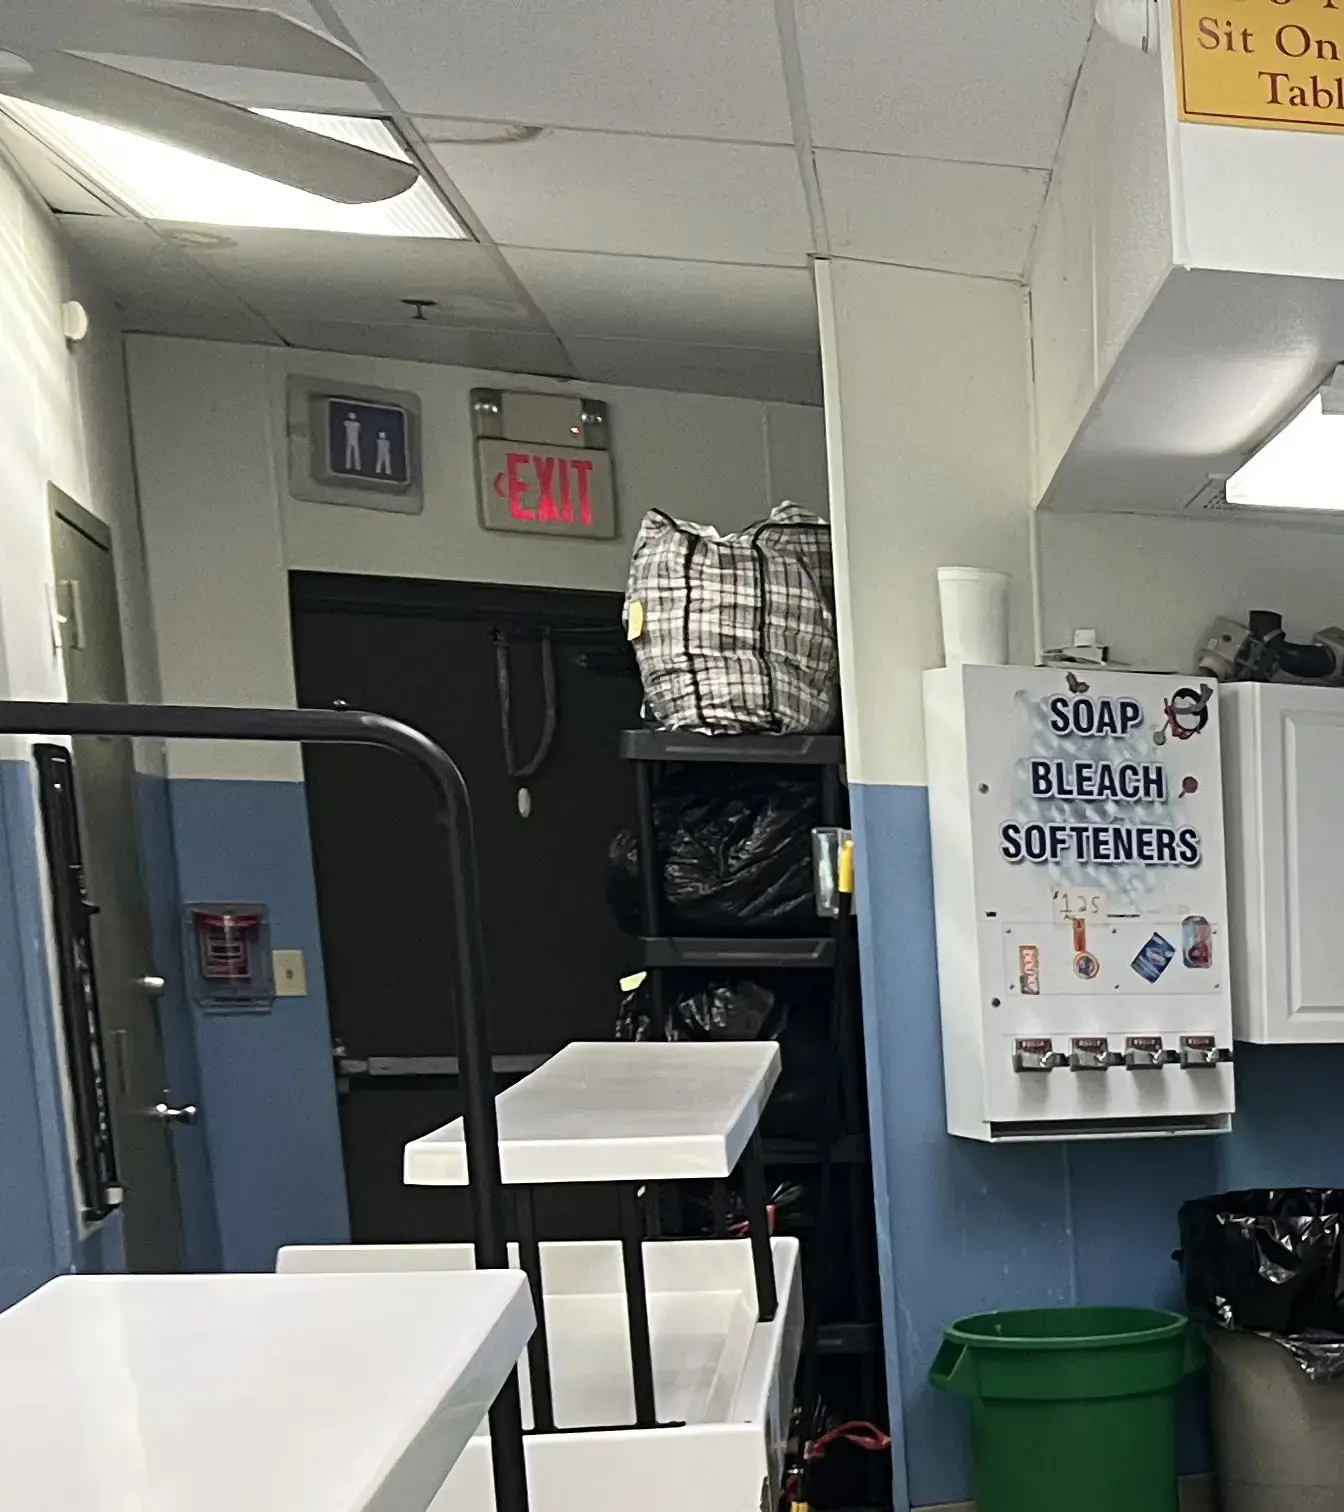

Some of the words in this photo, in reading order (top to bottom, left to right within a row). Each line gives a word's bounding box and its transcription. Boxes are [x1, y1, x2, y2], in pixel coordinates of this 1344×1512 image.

[1196, 16, 1255, 54] Sit
[1275, 24, 1341, 61] On
[506, 452, 593, 526] EXIT
[1049, 696, 1142, 736] SOAP
[1030, 760, 1165, 799] BLEACH
[1000, 822, 1201, 864] SOFTENERS
